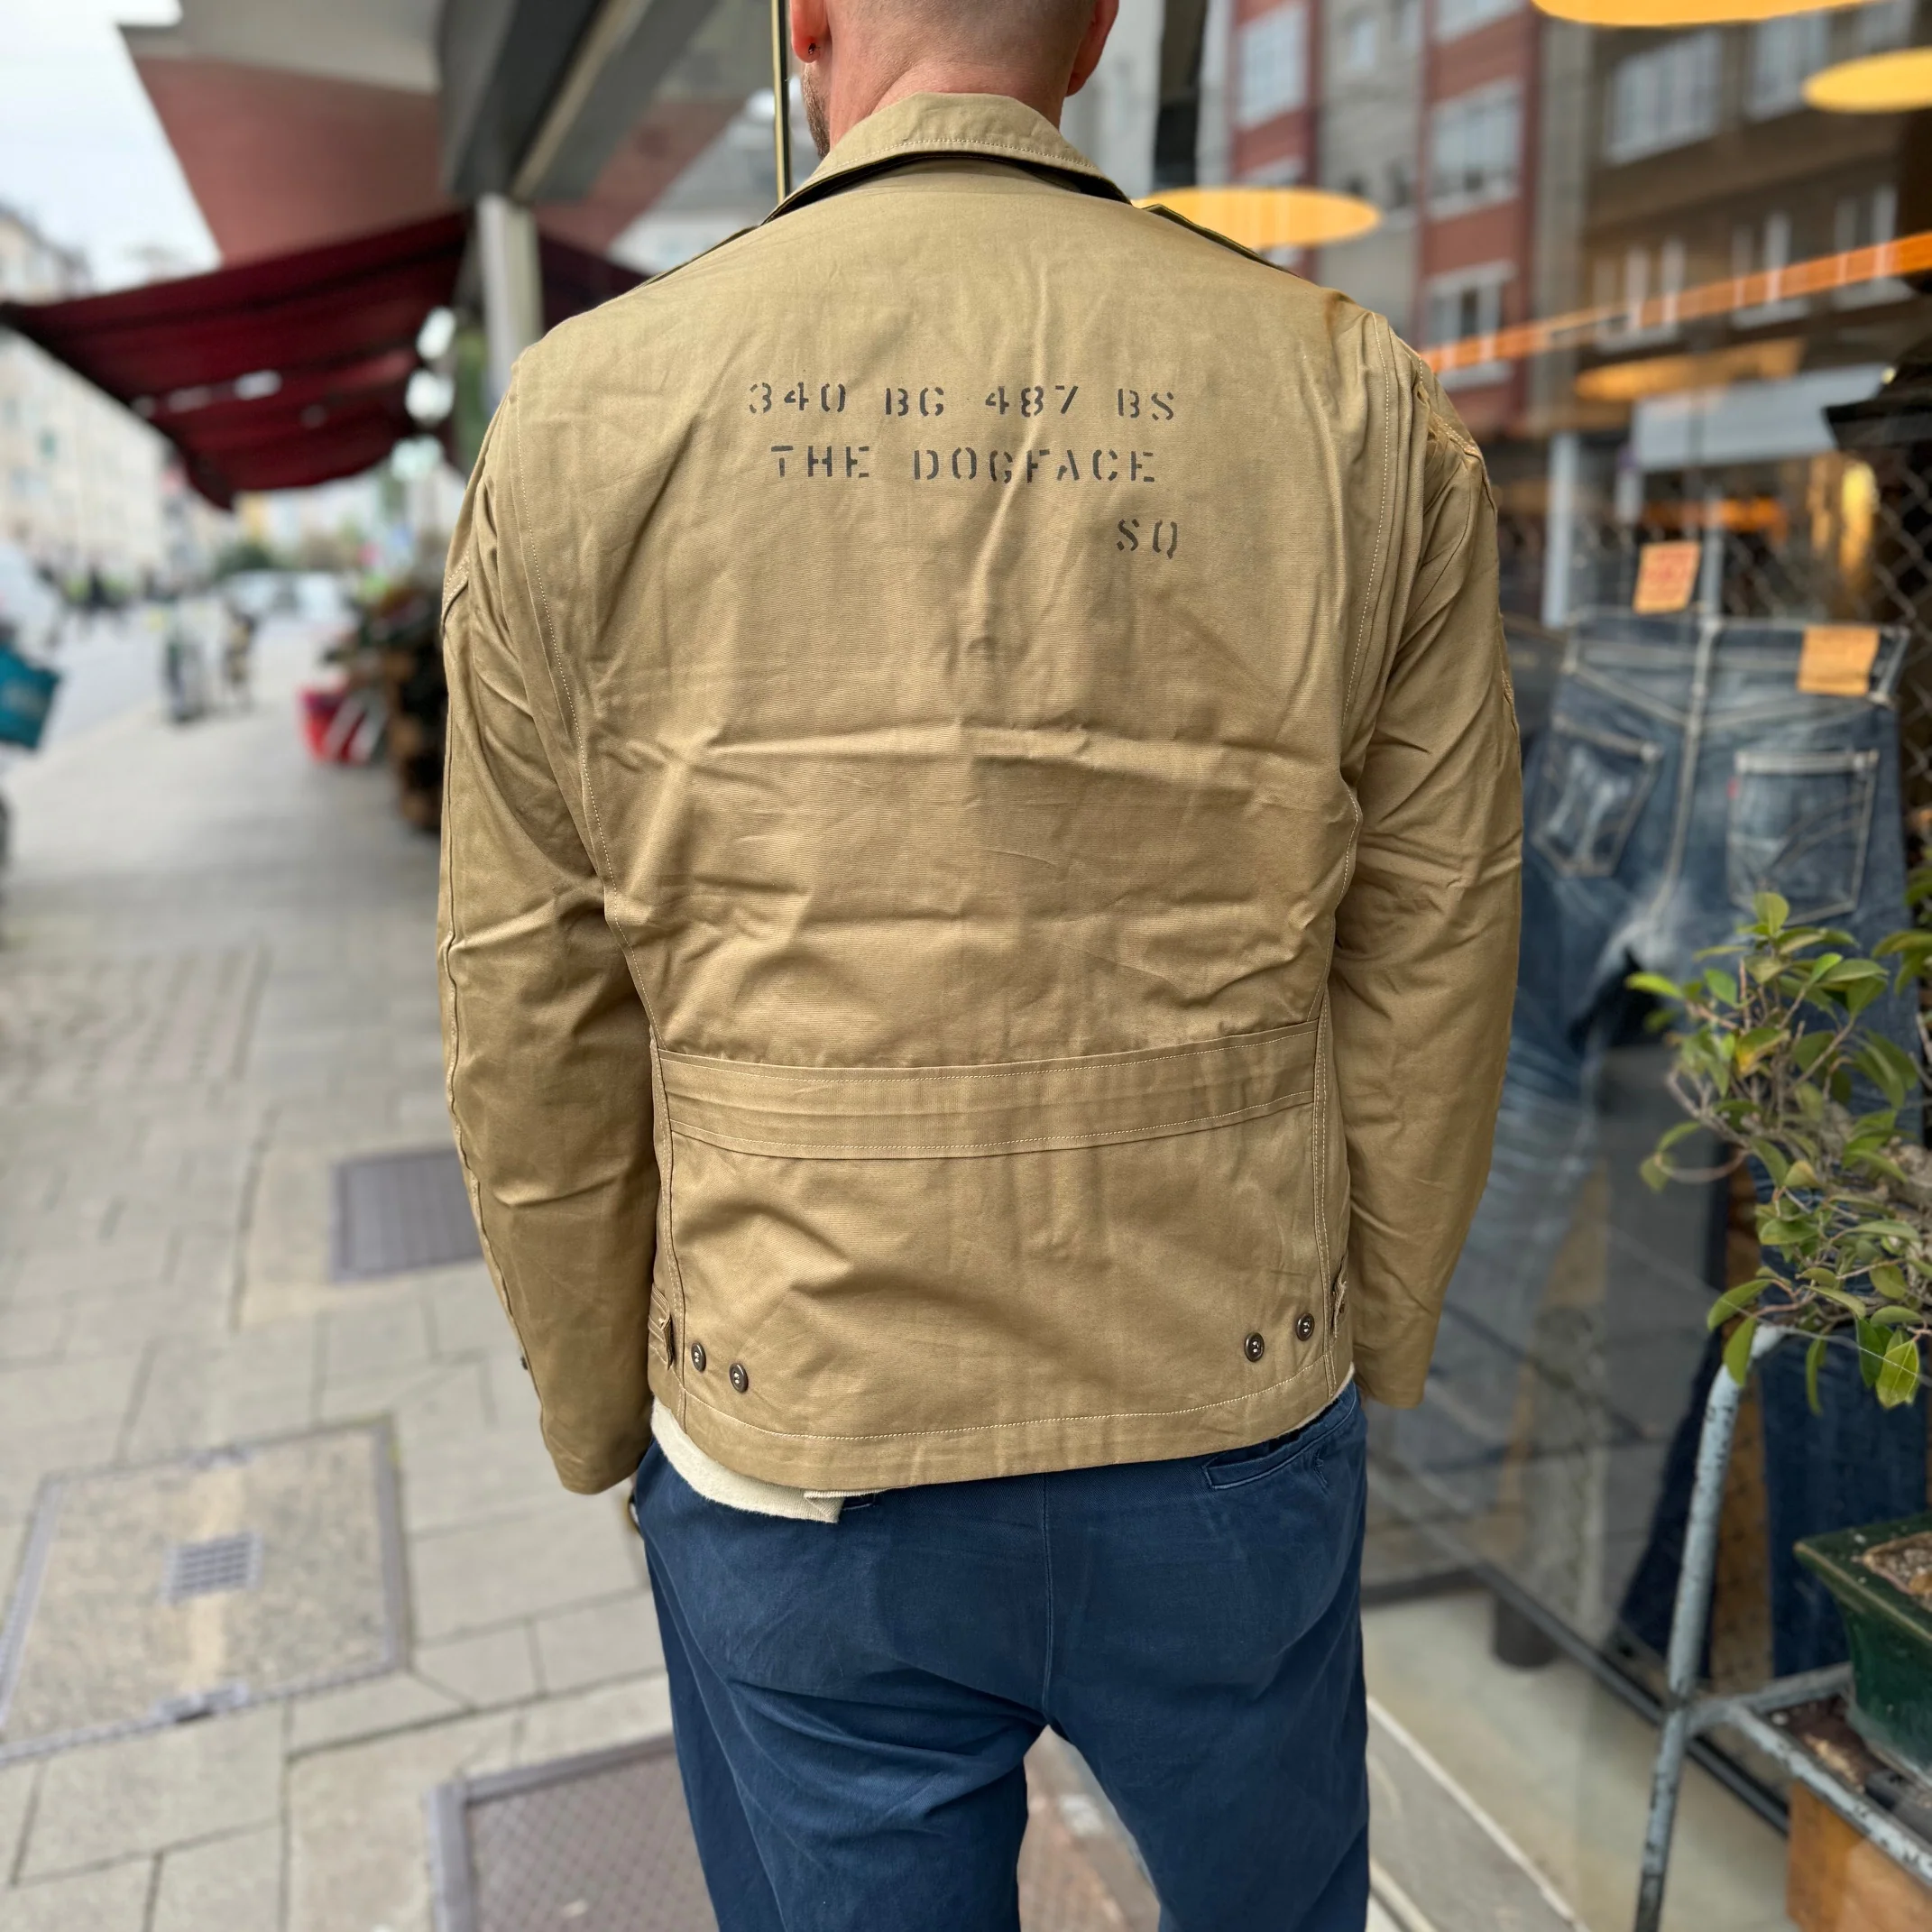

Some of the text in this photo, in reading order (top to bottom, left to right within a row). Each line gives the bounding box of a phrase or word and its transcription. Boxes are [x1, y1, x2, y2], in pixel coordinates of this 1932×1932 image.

[748, 382, 1174, 420] 340 BG 487 BS
[770, 445, 1155, 483] THE DOGFACE
[1116, 519, 1179, 559] SQ
